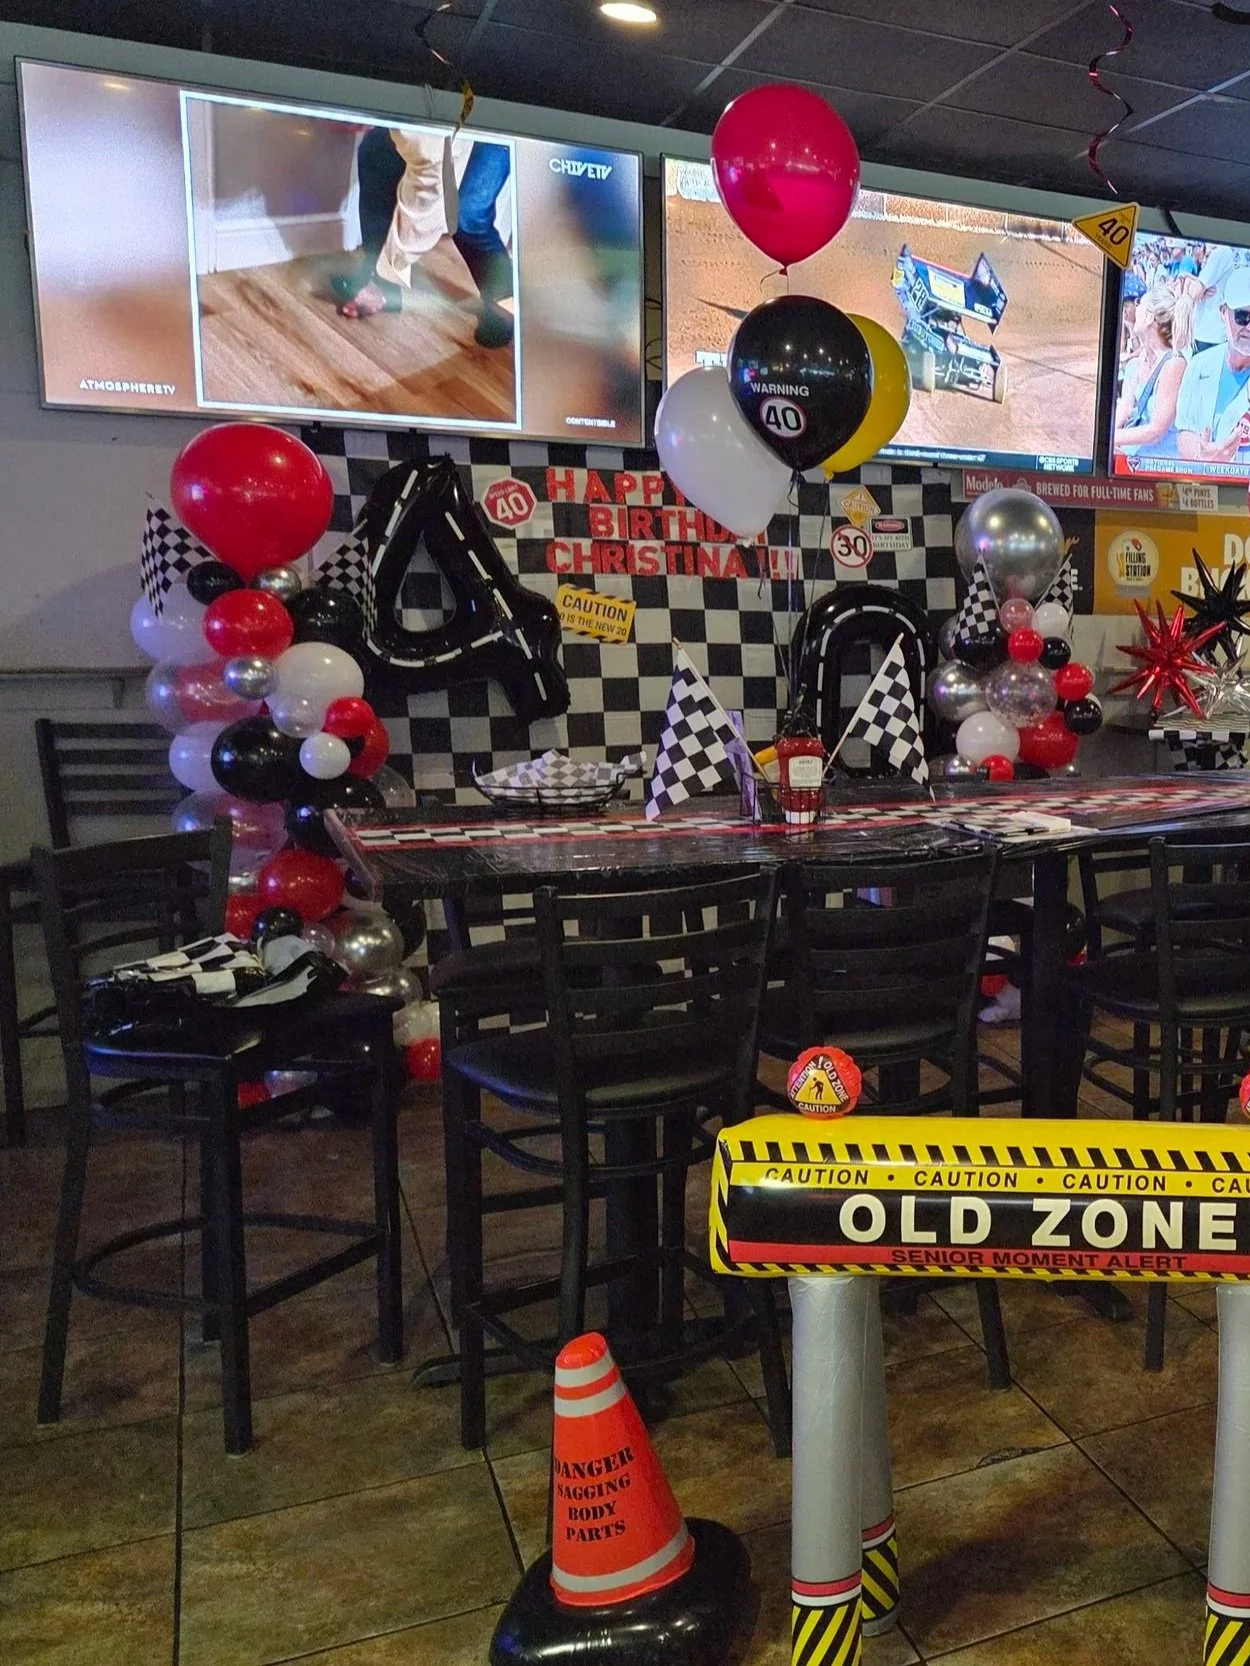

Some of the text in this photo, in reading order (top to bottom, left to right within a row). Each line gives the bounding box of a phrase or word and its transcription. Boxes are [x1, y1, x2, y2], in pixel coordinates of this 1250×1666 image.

[1098, 217, 1130, 246] 40
[750, 382, 810, 397] WARNING
[765, 405, 802, 431] 40
[1043, 464, 1075, 473] NETWORK
[966, 475, 1003, 490] Modelo
[1036, 482, 1070, 497] BREWED
[1073, 485, 1088, 498] FOR
[1134, 488, 1154, 502] FANS
[496, 492, 529, 520] 40
[843, 501, 876, 514] CAUTION
[837, 535, 867, 557] 30
[1126, 552, 1146, 564] FILLING
[1126, 565, 1151, 578] STATION
[562, 594, 628, 623] CAUTION
[566, 614, 575, 623] IS
[578, 616, 594, 628] THE
[596, 618, 614, 633] NEW
[616, 626, 627, 636] 20
[824, 1060, 838, 1080] OLD
[831, 1080, 849, 1103] ZONE
[798, 1102, 836, 1114] CAUTION
[765, 1167, 869, 1185] CAUTION
[914, 1171, 1018, 1188] CAUTION
[1063, 1174, 1166, 1192] CAUTION
[839, 1194, 1237, 1251] OLD ZONE
[892, 1250, 1188, 1270] SENIOR MOMENT ALERT
[551, 1446, 635, 1480] DANGER
[557, 1474, 632, 1502] SAGGING
[568, 1500, 618, 1522] BODY
[565, 1519, 628, 1543] PARTS
